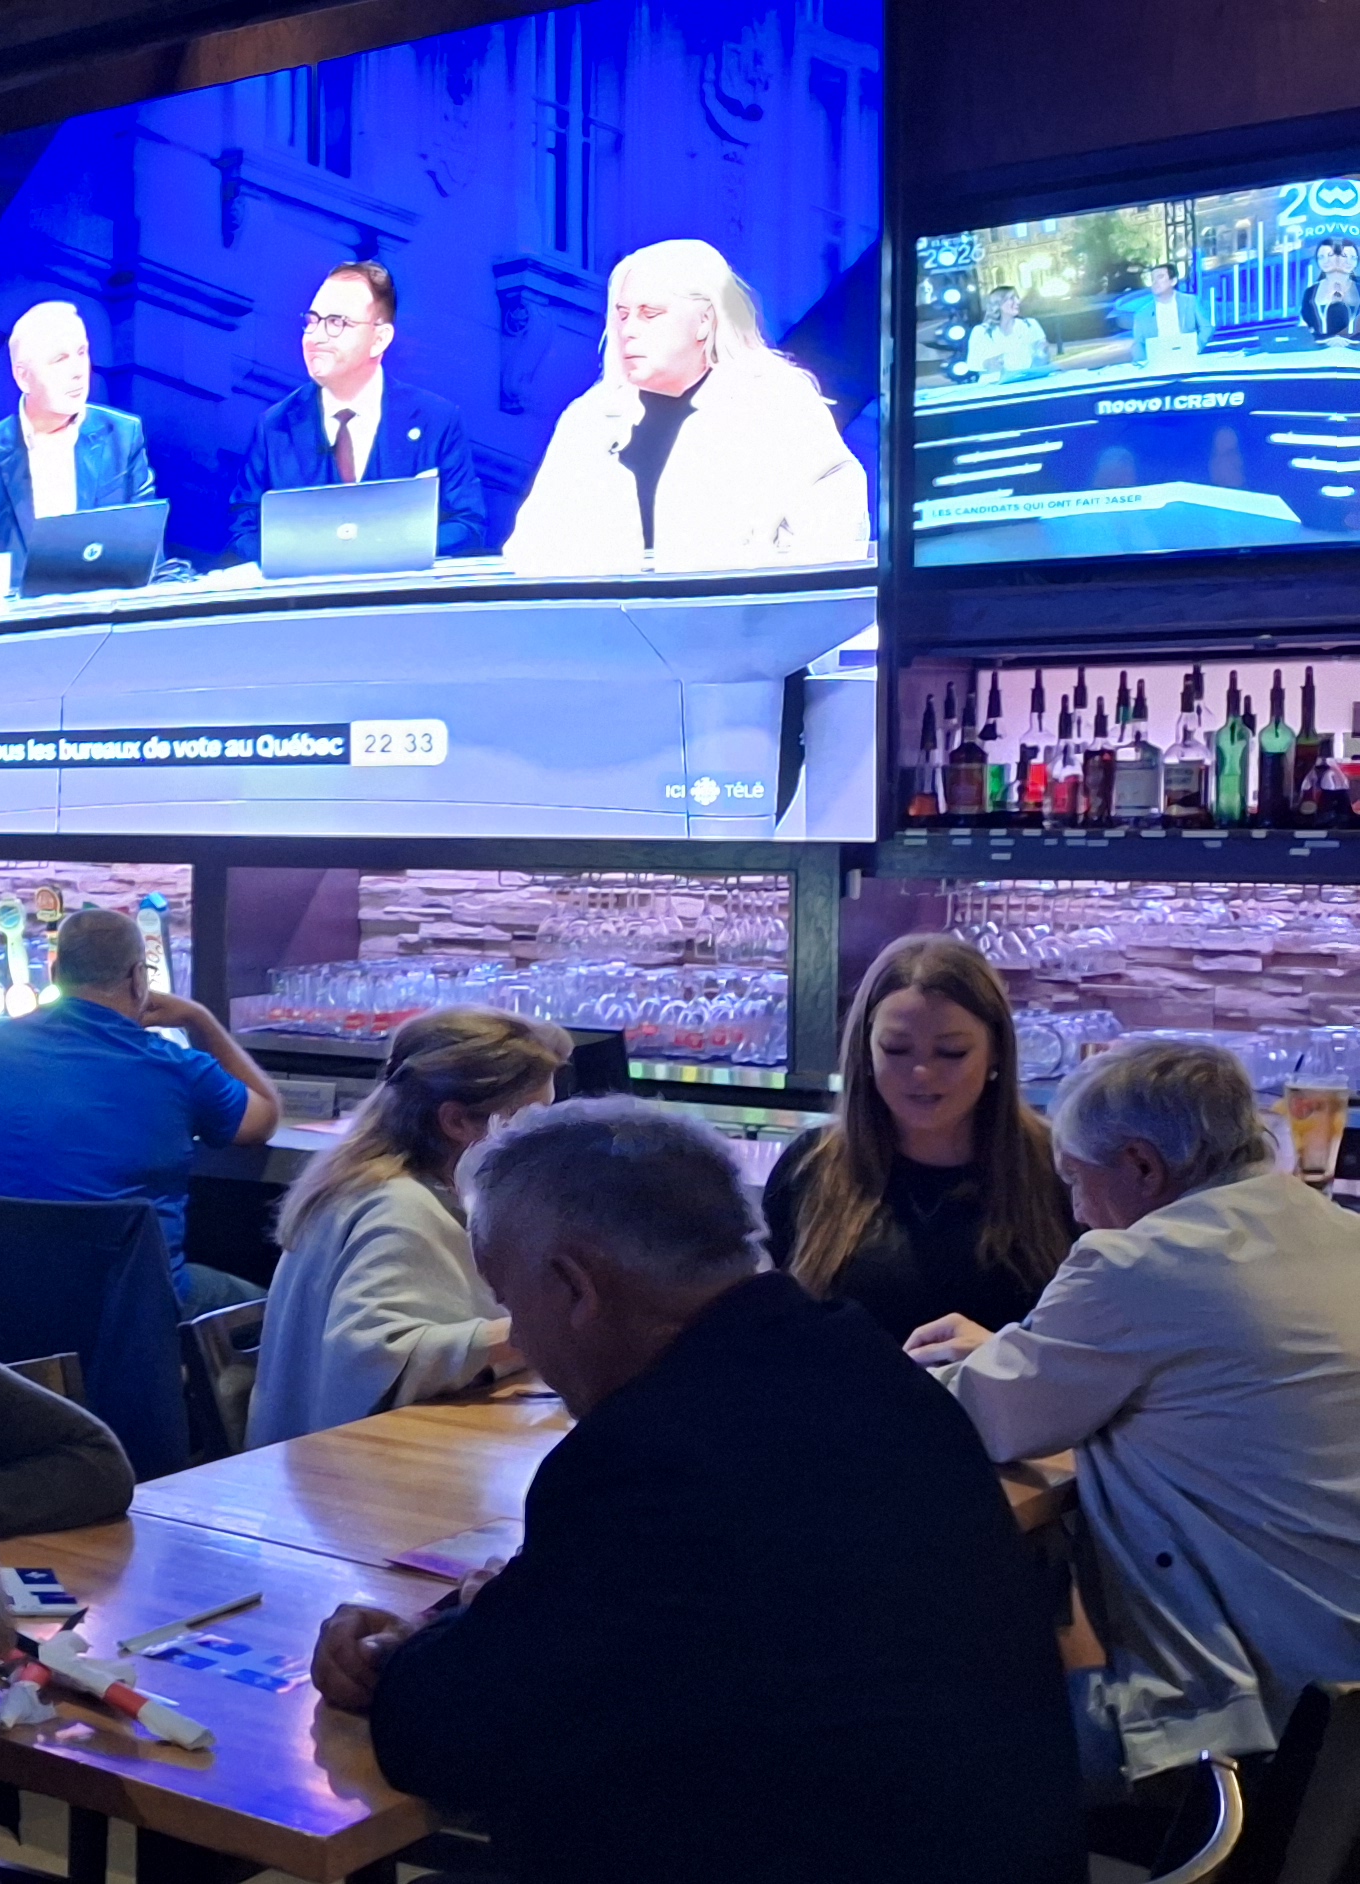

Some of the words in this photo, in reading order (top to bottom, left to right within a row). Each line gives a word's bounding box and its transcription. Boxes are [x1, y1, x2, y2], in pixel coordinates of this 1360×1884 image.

[1098, 398, 1162, 414] noovo
[955, 503, 1019, 516] CANDIDATS
[1024, 502, 1044, 512] QUI
[1047, 499, 1071, 509] ONT
[1076, 497, 1100, 507] FAIT
[28, 739, 56, 760] les
[59, 737, 140, 760] bureaux
[143, 736, 171, 759] de
[173, 737, 222, 758] vote
[224, 739, 253, 757] au
[256, 733, 344, 758] Québec
[665, 784, 686, 799] ICI
